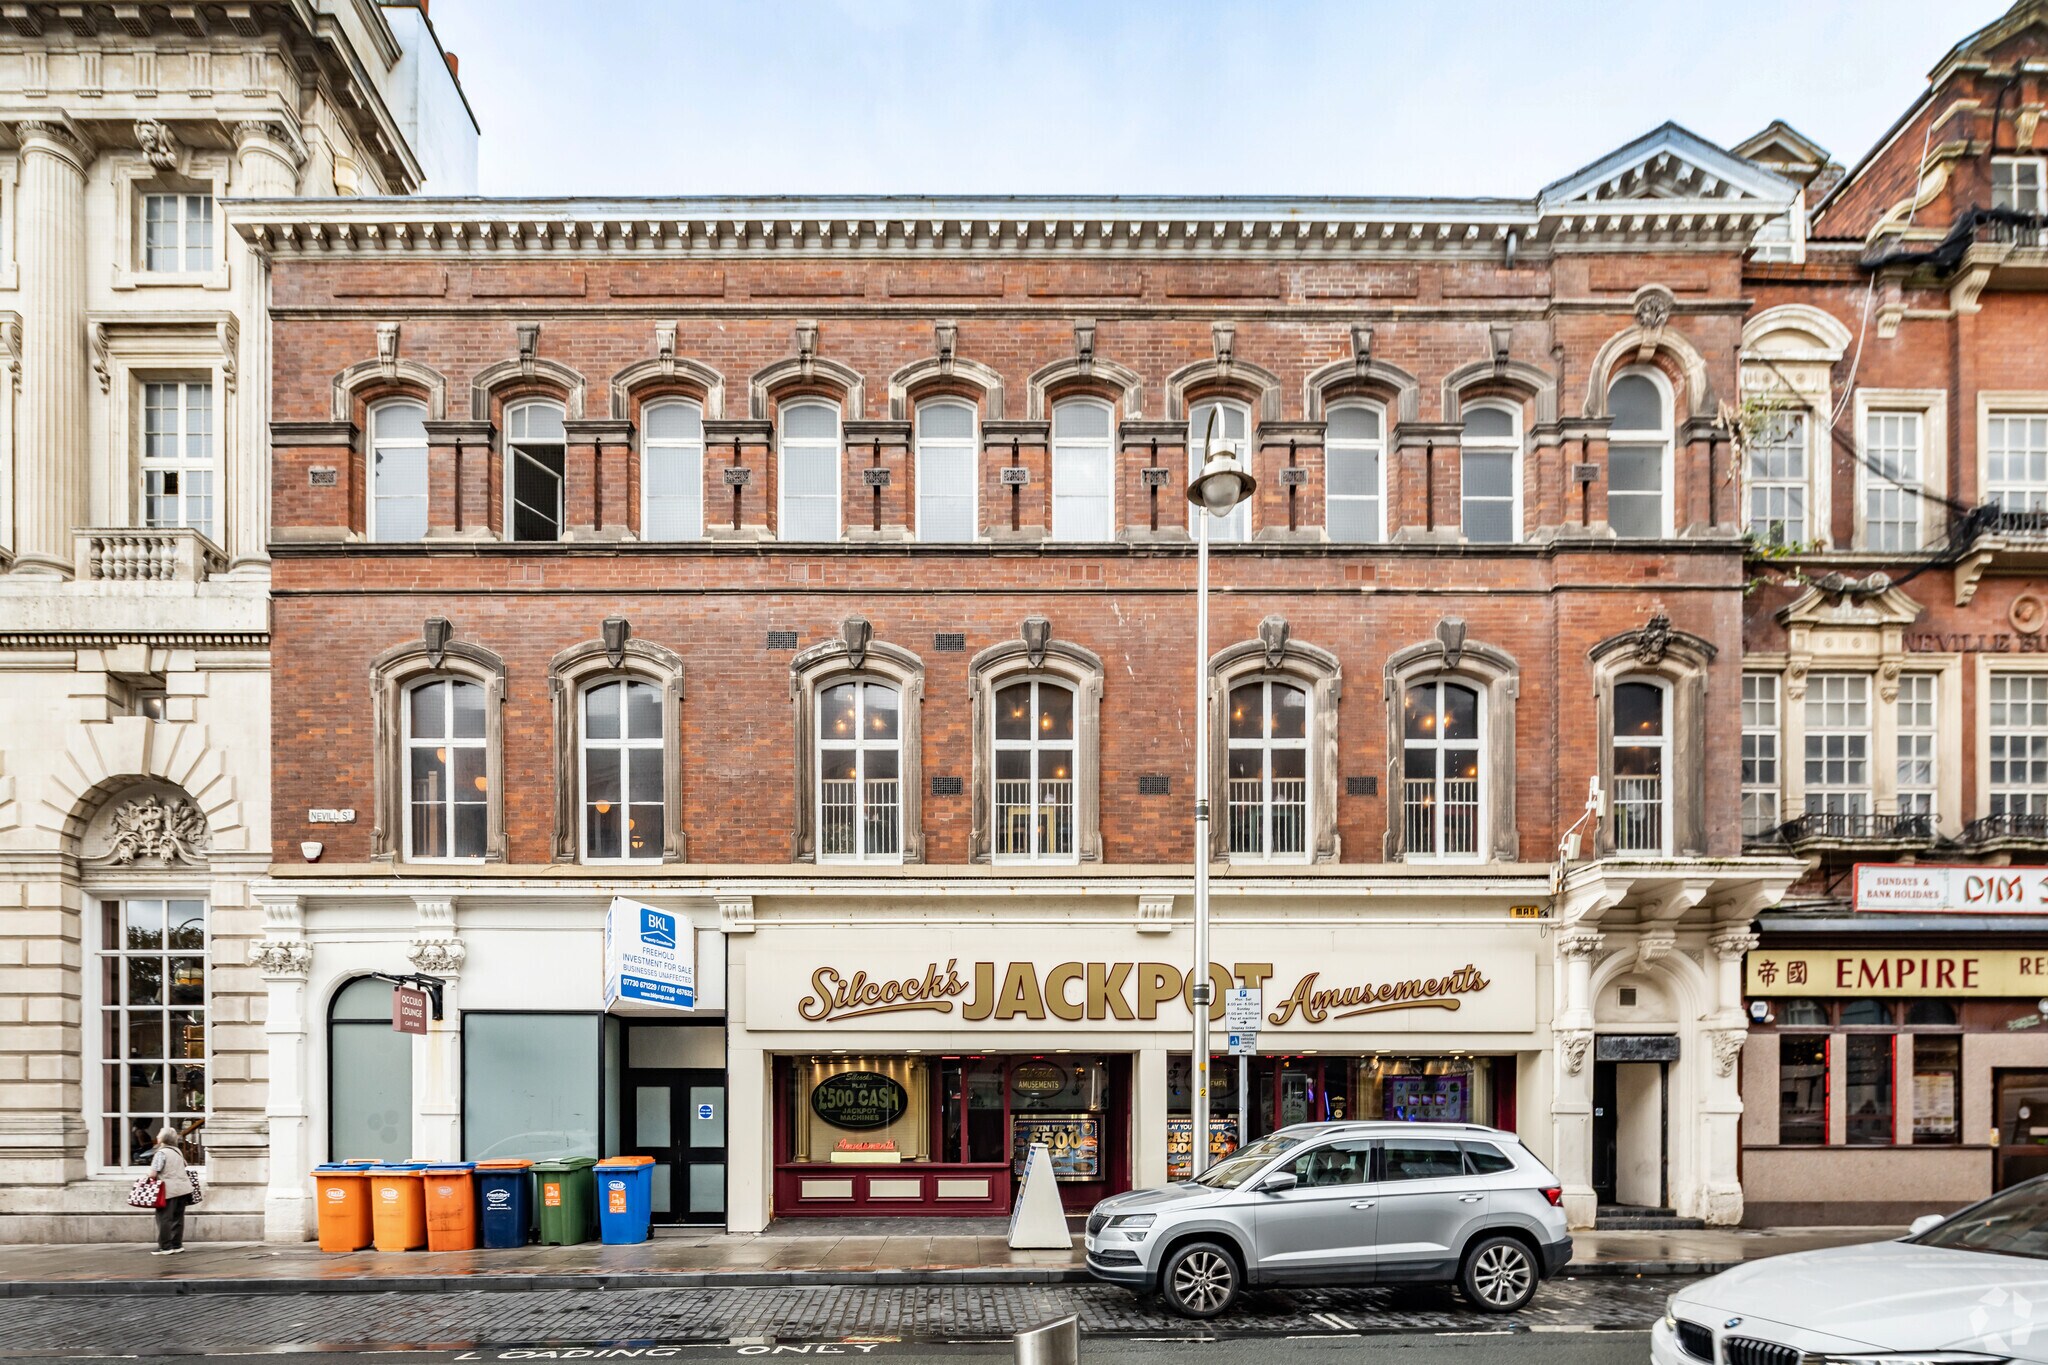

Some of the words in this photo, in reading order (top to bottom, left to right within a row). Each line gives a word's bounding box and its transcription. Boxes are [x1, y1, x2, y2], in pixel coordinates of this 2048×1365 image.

[311, 811, 339, 820] NEVILL
[1876, 877, 1919, 886] SUNDAYS
[1923, 878, 1930, 886] &
[1965, 875, 2023, 904] DIM
[1866, 889, 1892, 899] BANK
[1894, 889, 1940, 899] HOLIDAYS
[648, 914, 669, 932] BKL
[642, 946, 674, 960] FREEHOLD
[622, 953, 662, 968] INVESTMENT
[664, 962, 676, 972] FOR
[678, 965, 692, 974] SALE
[1836, 958, 1979, 988] EMPIRE
[2019, 956, 2048, 975] RE
[623, 964, 658, 977] BUSINESSES
[658, 972, 692, 984] UNAFFECTED
[1758, 959, 1808, 988] 帝國
[798, 958, 969, 1021] Silcock's
[962, 961, 1273, 1020] JACKPOT
[1268, 963, 1490, 1025] Amusements
[402, 1006, 422, 1018] LOUNGE
[1018, 1080, 1059, 1089] AMUSEMENTS
[818, 1086, 854, 1110] £500
[858, 1086, 898, 1111] CASH
[834, 1138, 896, 1151] Amusements
[1028, 1132, 1082, 1149] £500
[454, 1347, 682, 1360] LOADING
[736, 1344, 879, 1355] ONLY
